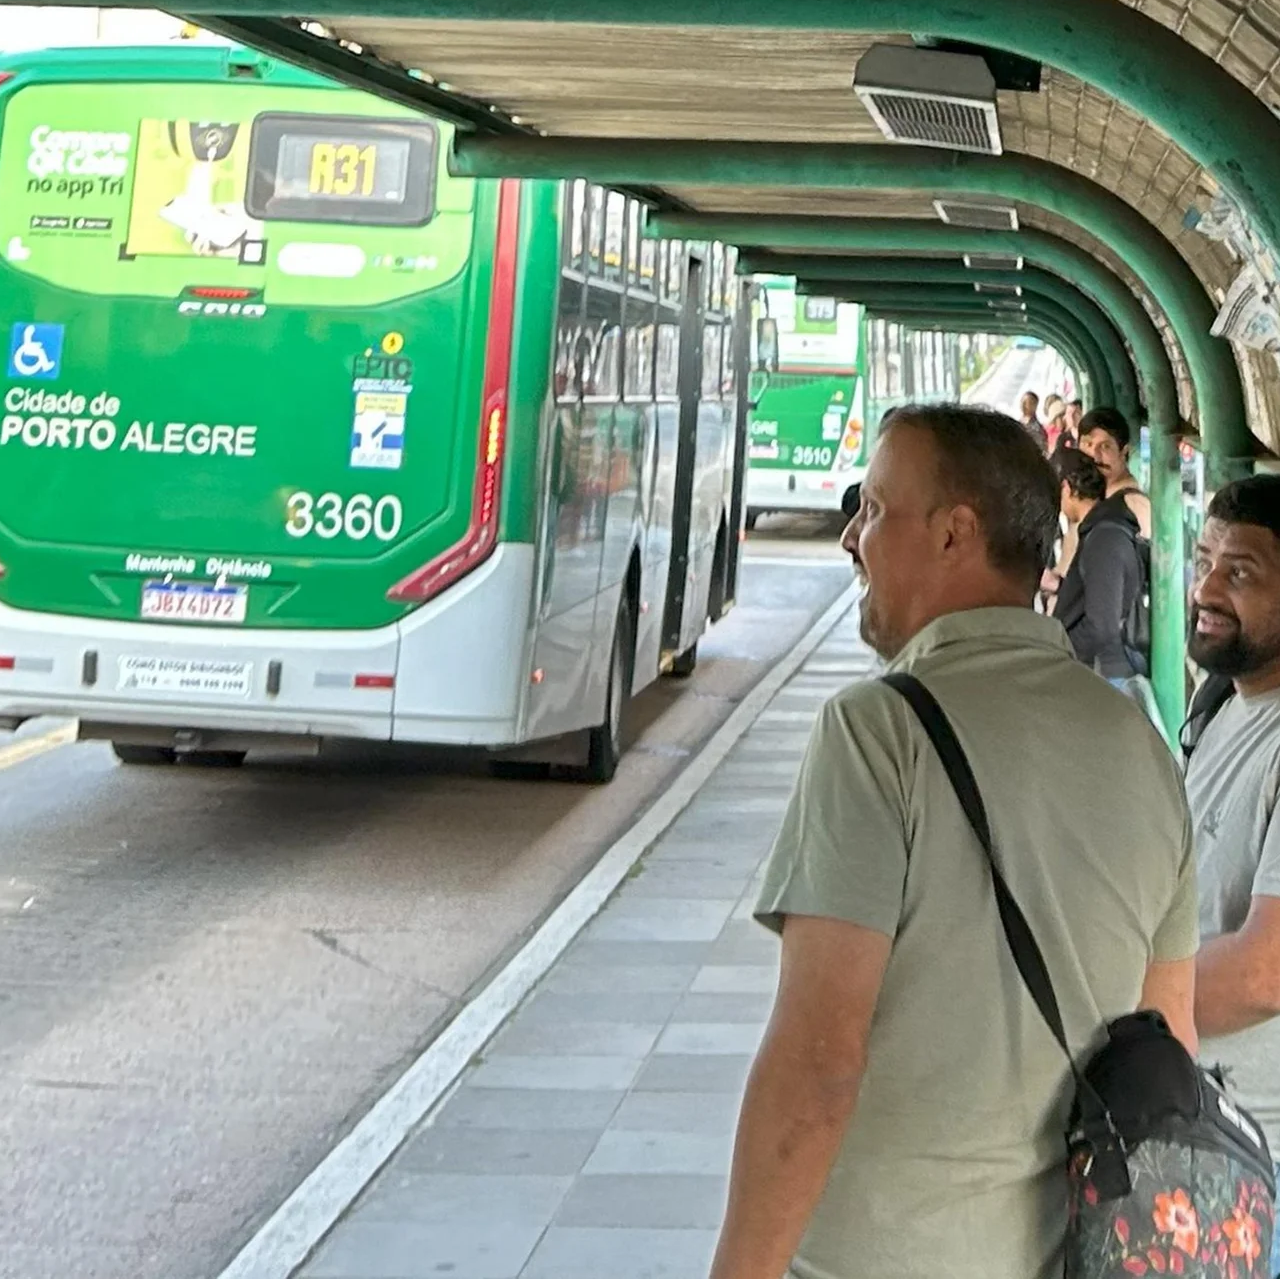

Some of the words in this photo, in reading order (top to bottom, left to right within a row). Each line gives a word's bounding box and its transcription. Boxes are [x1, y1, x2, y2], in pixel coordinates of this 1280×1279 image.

[26, 178, 53, 193] no
[56, 178, 95, 199] app
[98, 175, 126, 195] Tri
[309, 143, 377, 196] R31
[4, 387, 87, 415] Cidade
[90, 391, 120, 417] de
[0, 415, 117, 451] PORTO
[120, 420, 258, 457] ALEGRE
[285, 491, 402, 541] 3360
